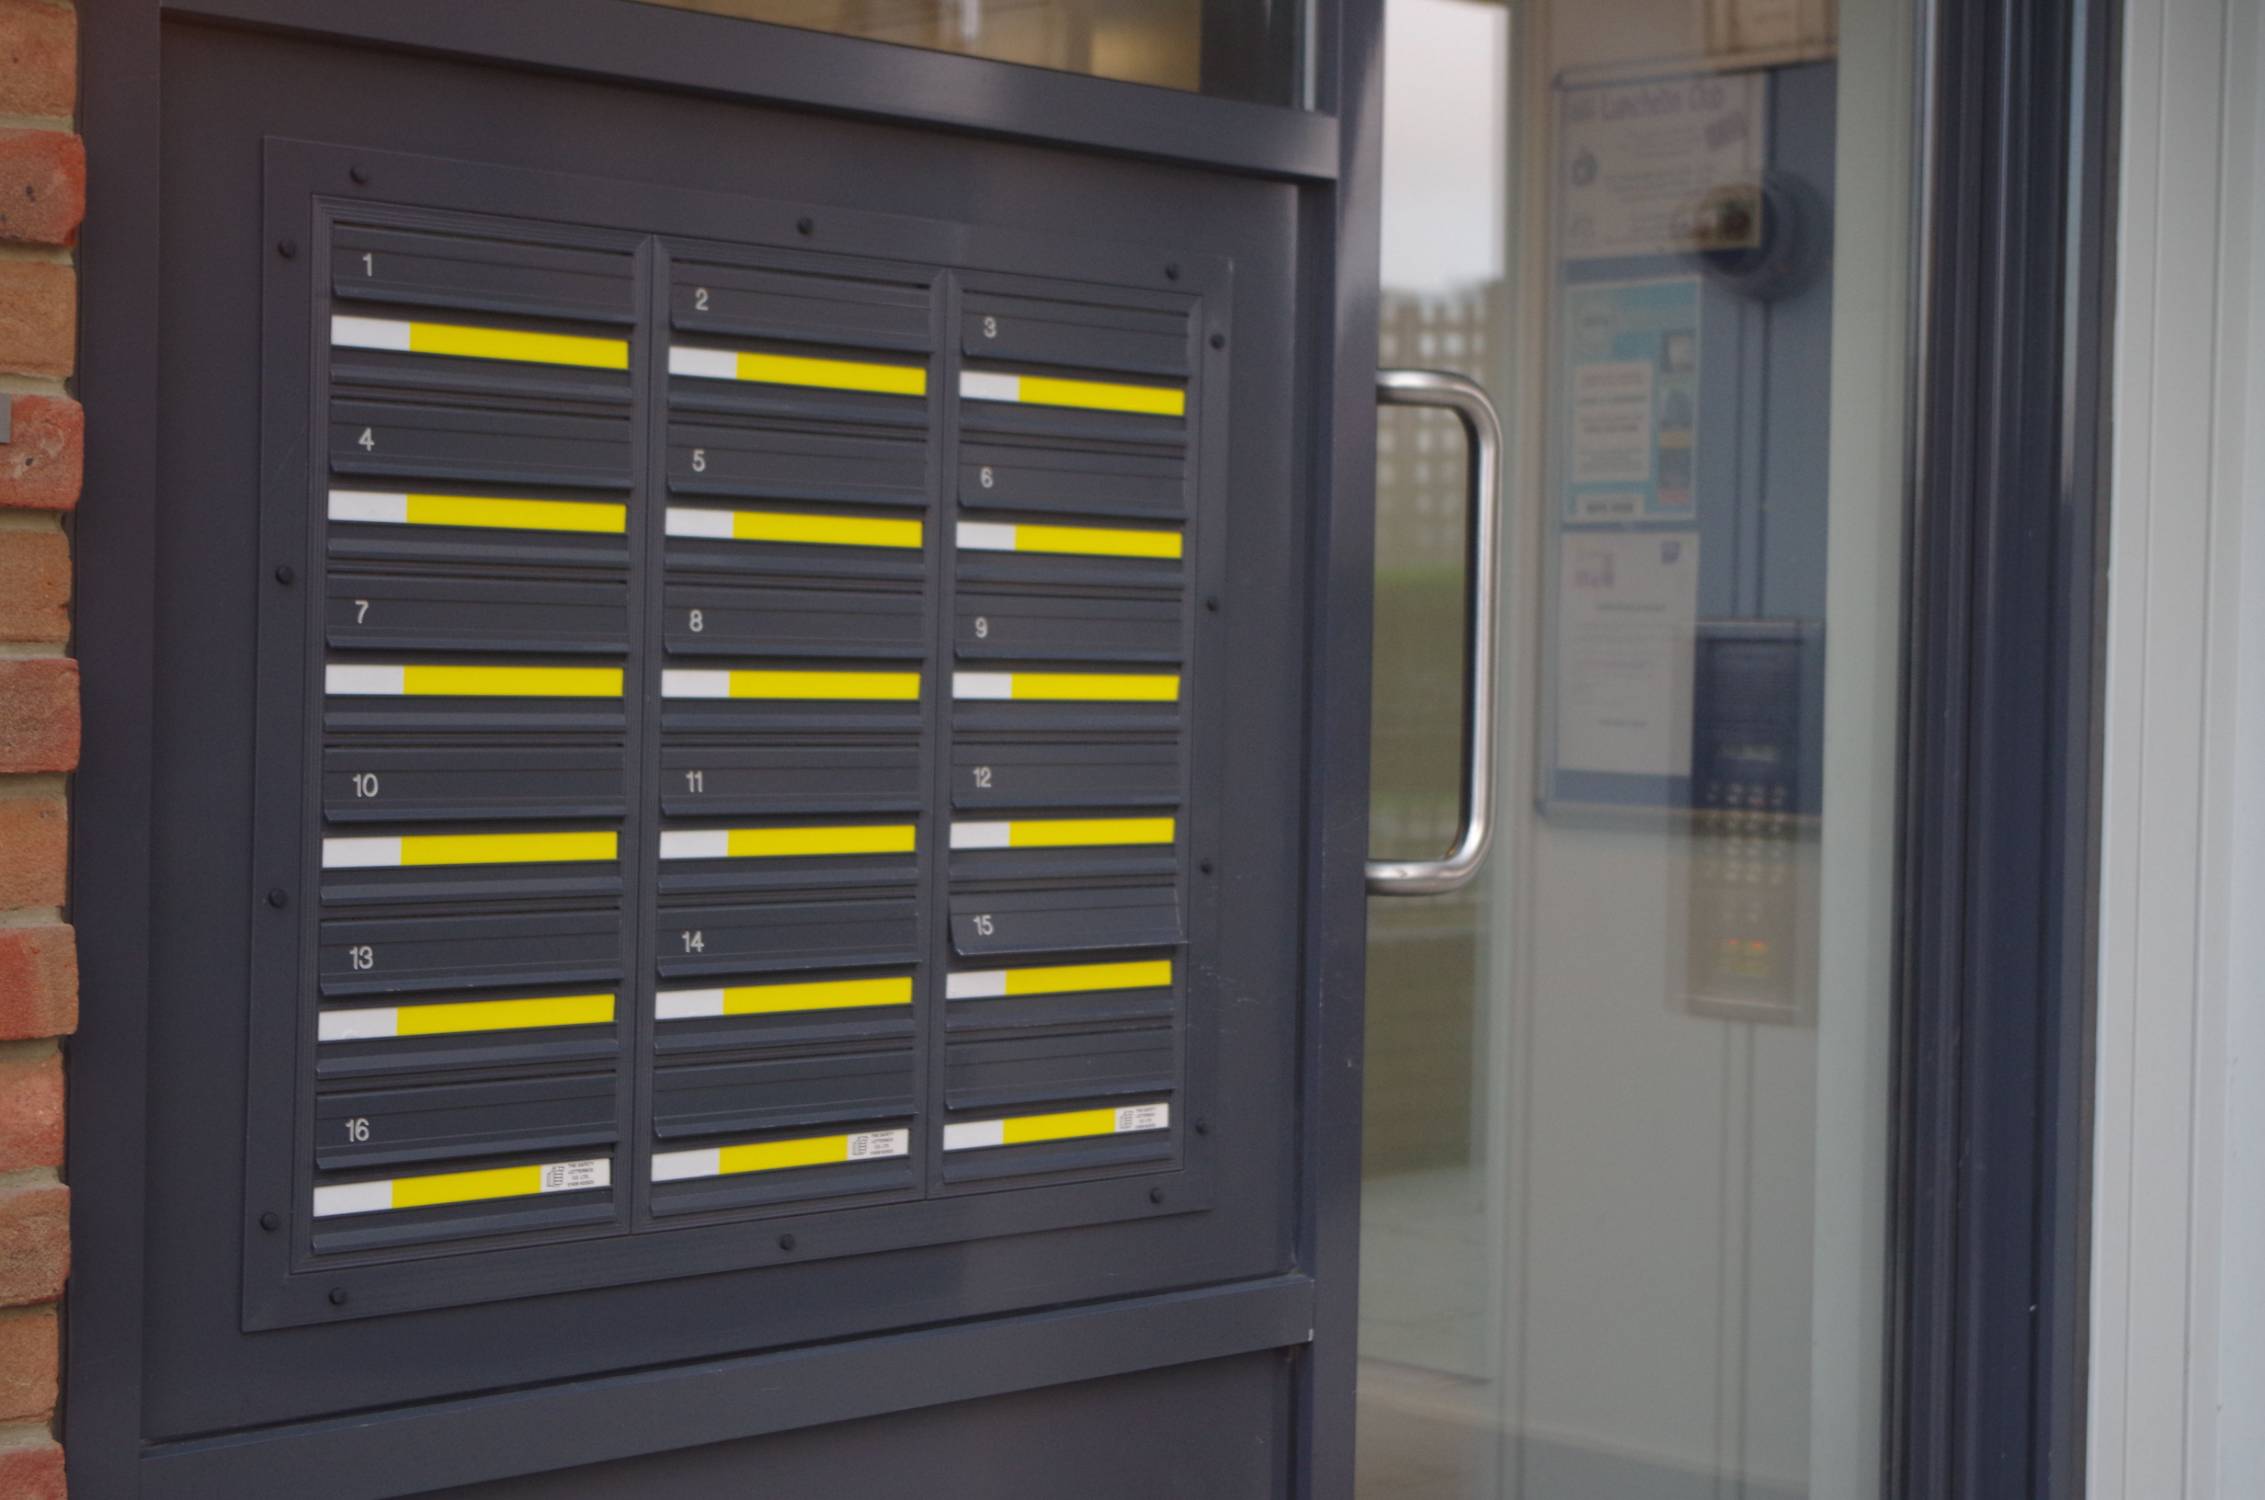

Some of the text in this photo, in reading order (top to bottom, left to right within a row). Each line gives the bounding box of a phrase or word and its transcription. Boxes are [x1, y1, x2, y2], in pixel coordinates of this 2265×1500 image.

[362, 253, 373, 277] 1
[695, 288, 709, 311] 2
[984, 316, 997, 338] 3
[358, 427, 375, 452] 4
[692, 449, 706, 473] 5
[980, 467, 993, 488] 6
[354, 599, 369, 625] 7
[689, 609, 704, 633] 8
[975, 617, 988, 639] 9
[352, 772, 379, 798] 10
[685, 771, 703, 793] 11
[973, 766, 992, 788] 12
[973, 914, 994, 936] 15
[681, 930, 705, 953] 14
[349, 945, 374, 970] 13
[345, 1117, 370, 1143] 16
